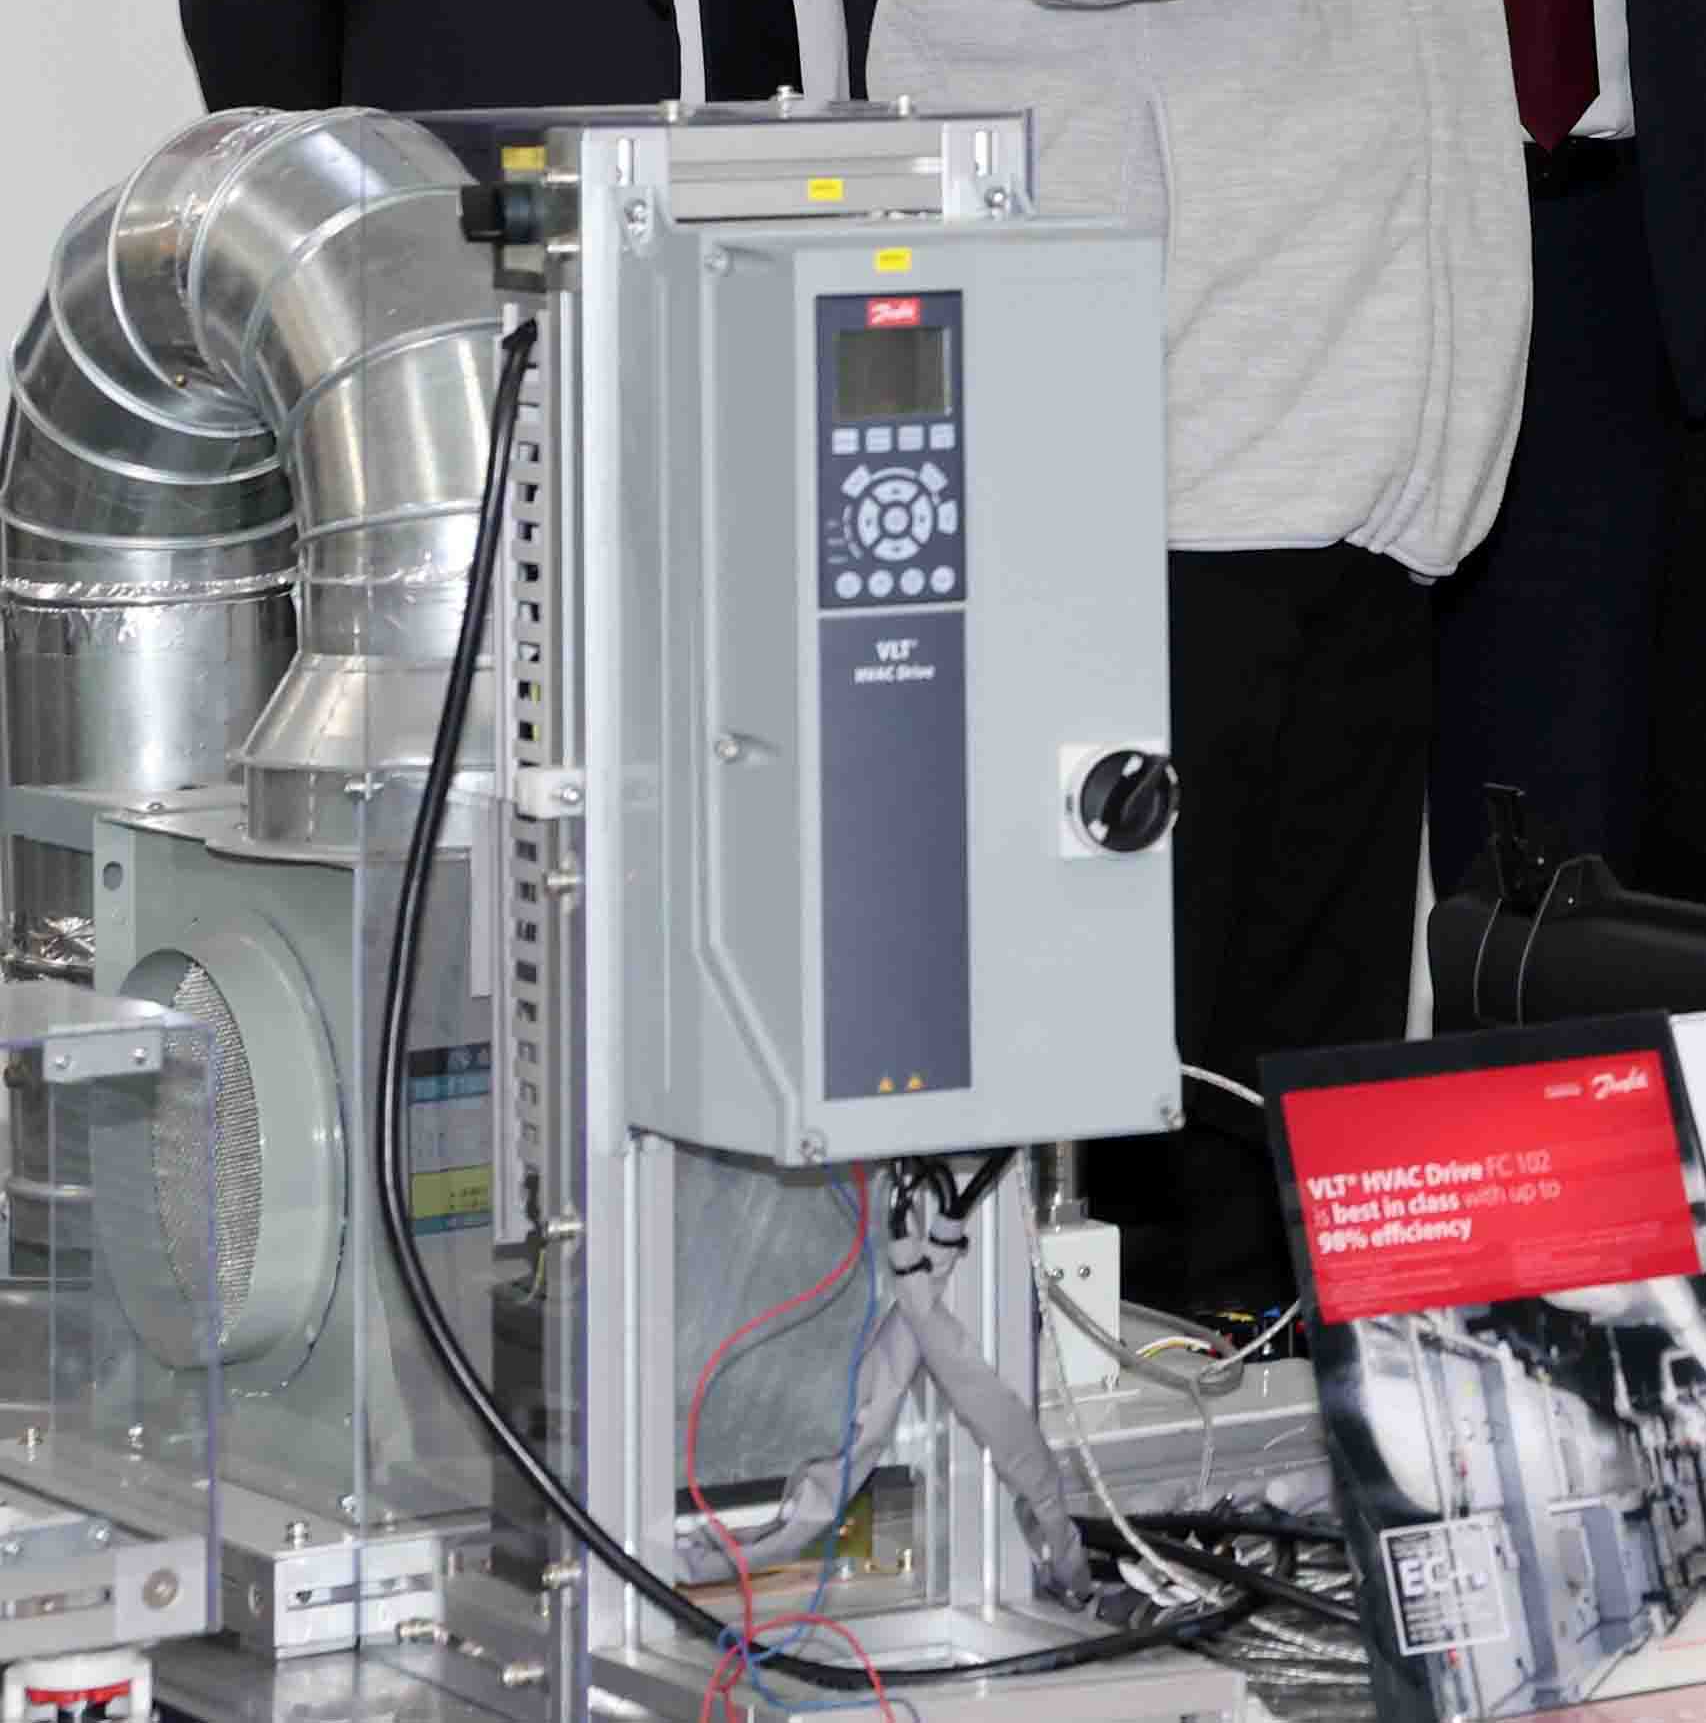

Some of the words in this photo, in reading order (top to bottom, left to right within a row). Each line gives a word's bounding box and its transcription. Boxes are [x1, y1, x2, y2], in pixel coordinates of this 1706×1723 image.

[1361, 1165, 1422, 1193] HVAC
[1425, 1160, 1484, 1186] Drive
[1486, 1153, 1514, 1178] FC
[1517, 1149, 1551, 1173] 102
[1331, 1200, 1381, 1225] best
[1383, 1195, 1406, 1218] in
[1408, 1191, 1460, 1215] class
[1462, 1185, 1505, 1208] with
[1508, 1182, 1537, 1207] up
[1538, 1178, 1562, 1200] to
[1317, 1228, 1368, 1254] 98%
[1371, 1217, 1472, 1247] efficiency
